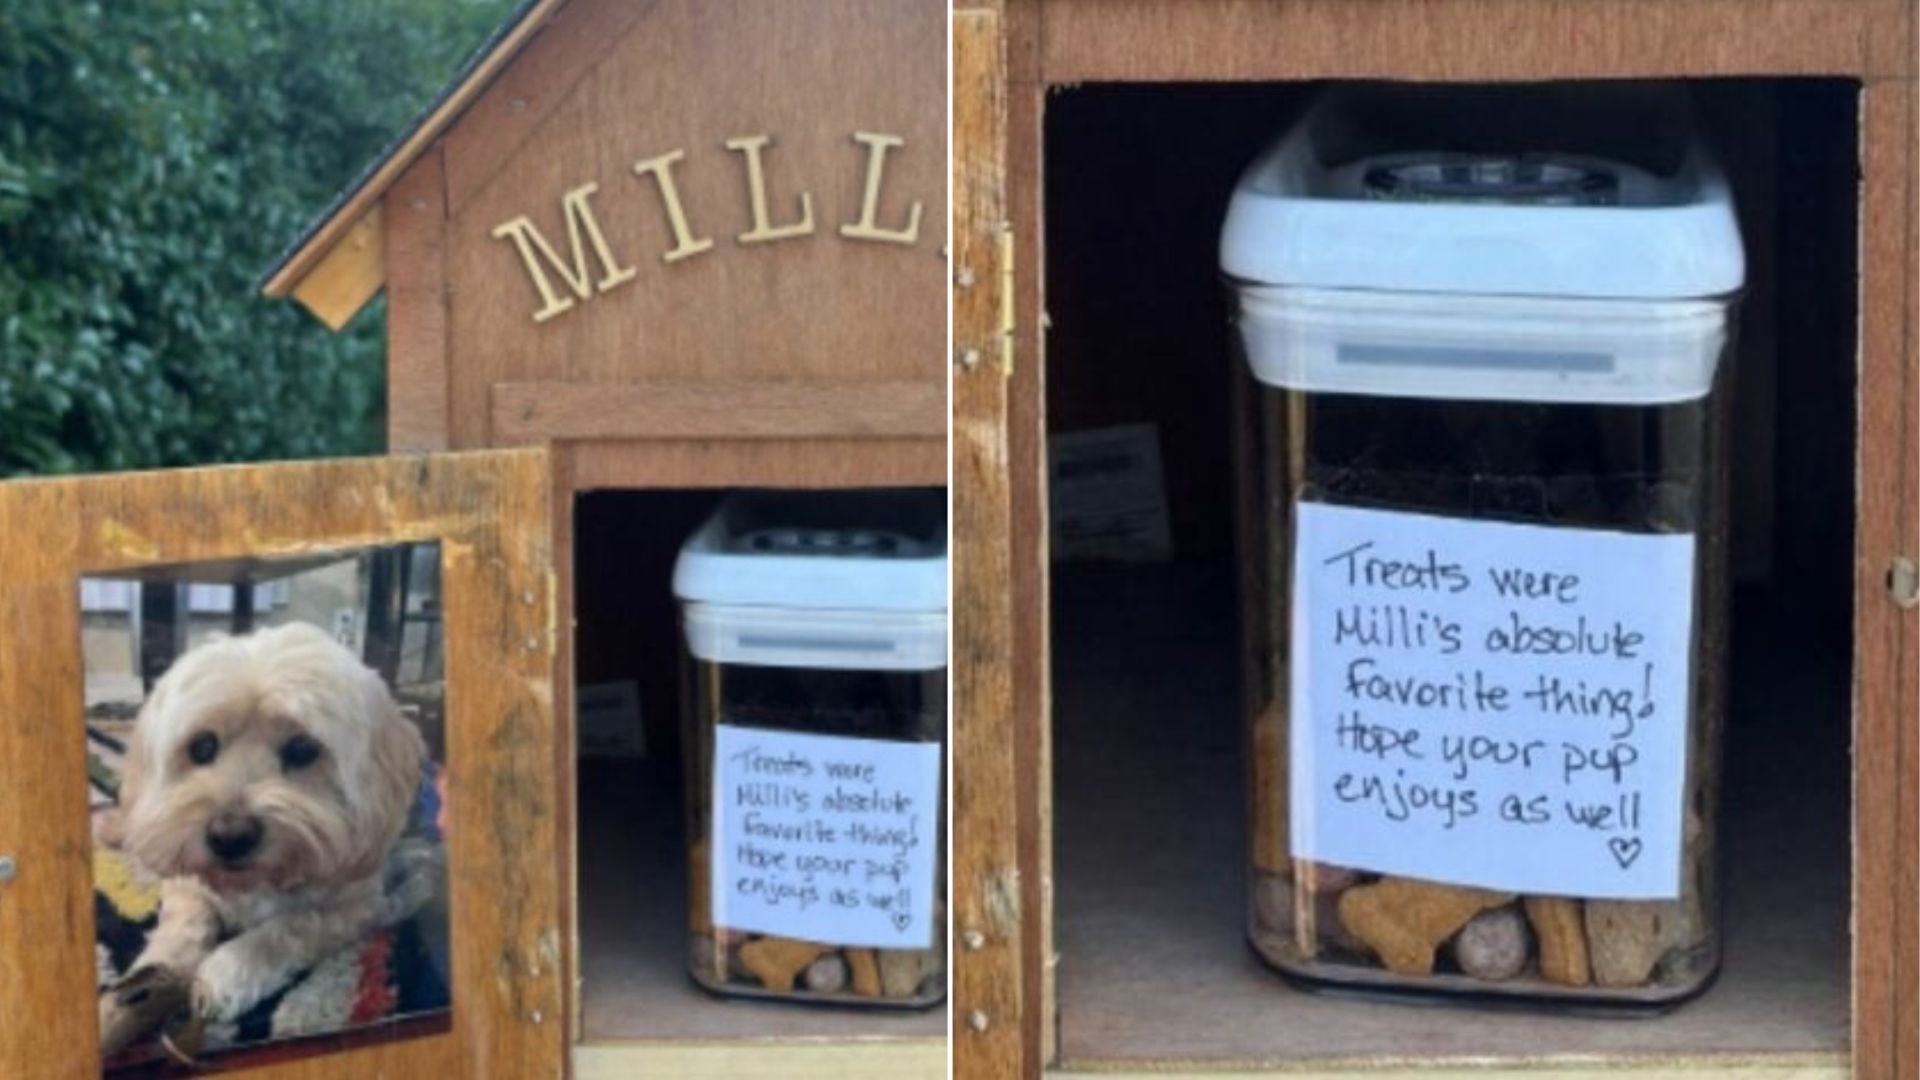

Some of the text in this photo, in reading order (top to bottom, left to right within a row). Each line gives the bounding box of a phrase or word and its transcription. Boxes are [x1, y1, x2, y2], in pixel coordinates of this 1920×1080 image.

[491, 131, 947, 323] MILL
[1324, 541, 1579, 602] Treats were
[1334, 606, 1645, 658] Milli's absolute
[1524, 662, 1655, 739] thing!
[731, 746, 874, 783] Treats were
[1336, 711, 1638, 784] Hope your pup
[822, 785, 912, 814] absolute
[1334, 769, 1641, 829] enjoys as well
[737, 843, 909, 883] Hope your pup
[737, 875, 911, 910] enjoys as well
